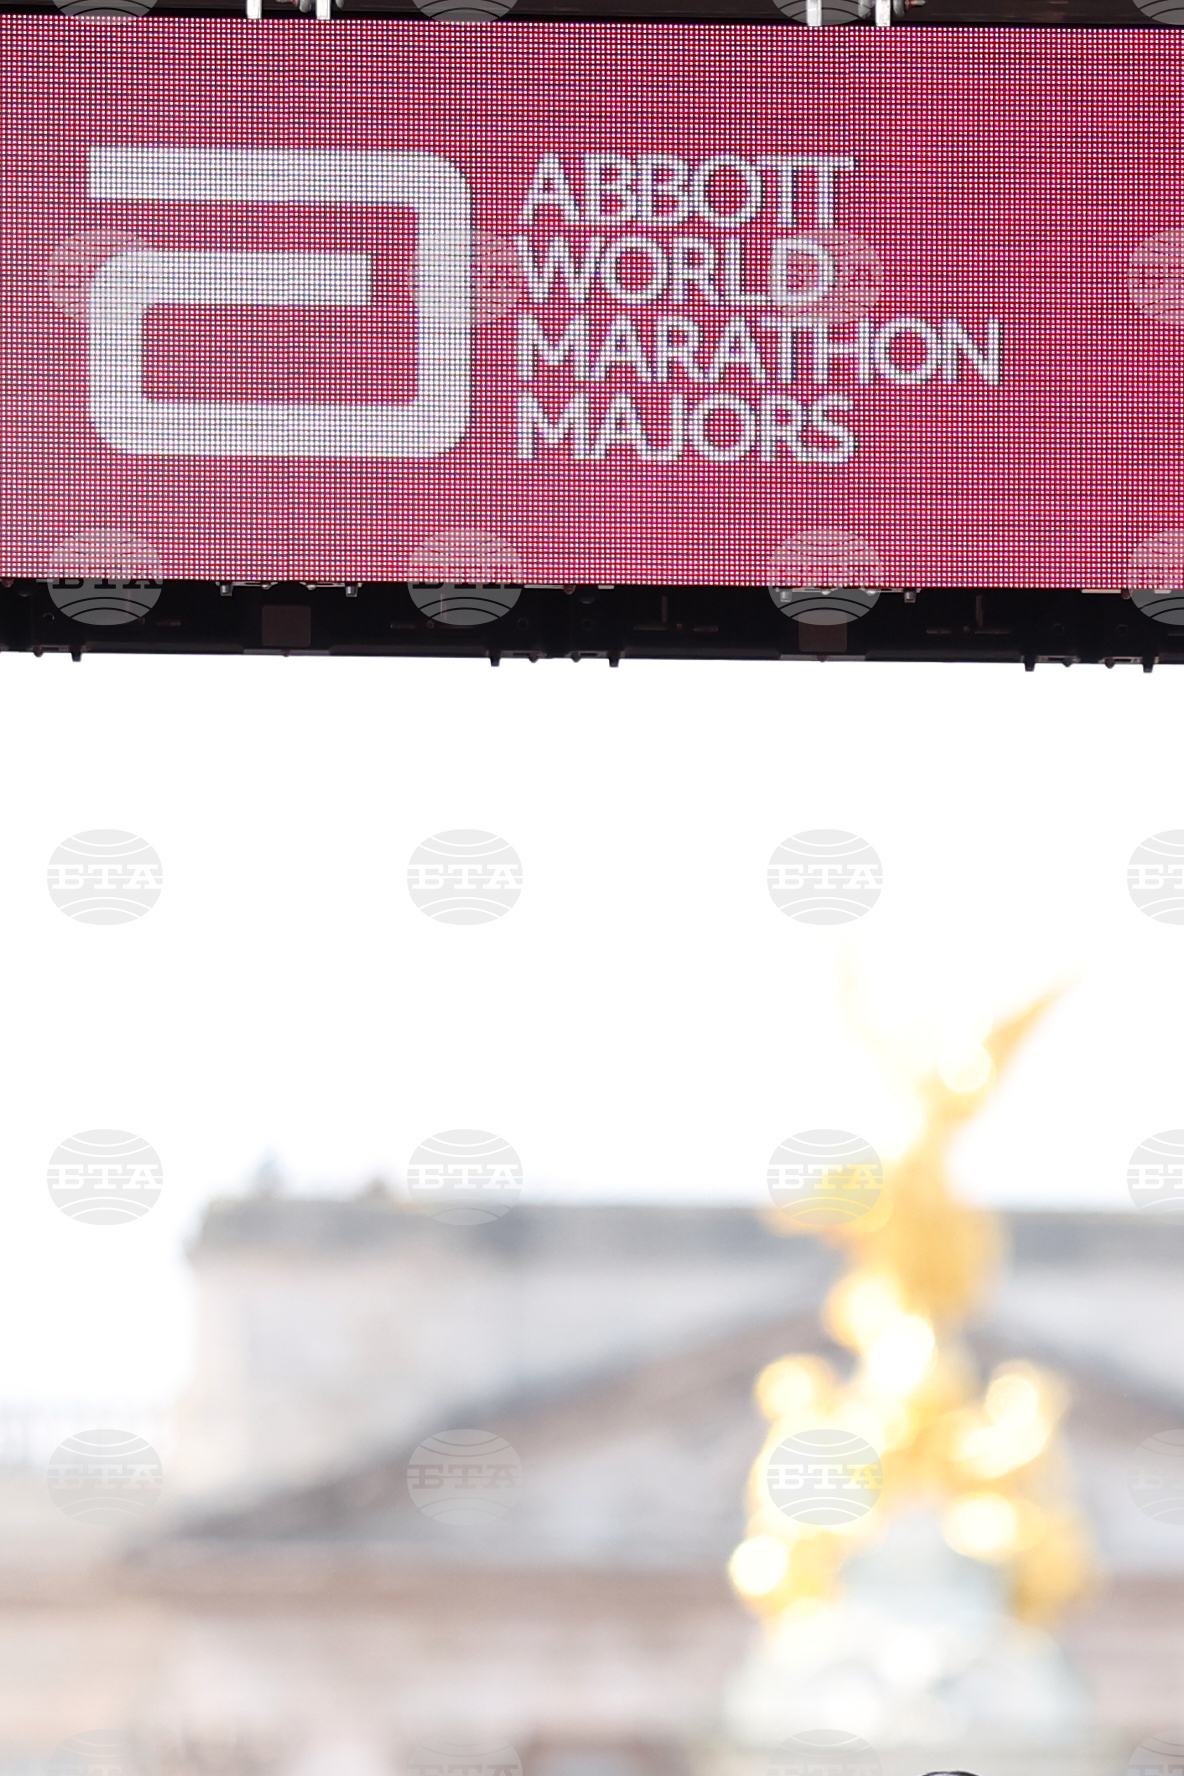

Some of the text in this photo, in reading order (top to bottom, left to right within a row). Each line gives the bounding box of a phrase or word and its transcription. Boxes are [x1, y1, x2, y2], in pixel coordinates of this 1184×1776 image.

[519, 154, 854, 227] ABBOTT
[517, 236, 832, 308] WORLD
[517, 316, 999, 384] MARATHON
[517, 393, 854, 463] MAJORS
